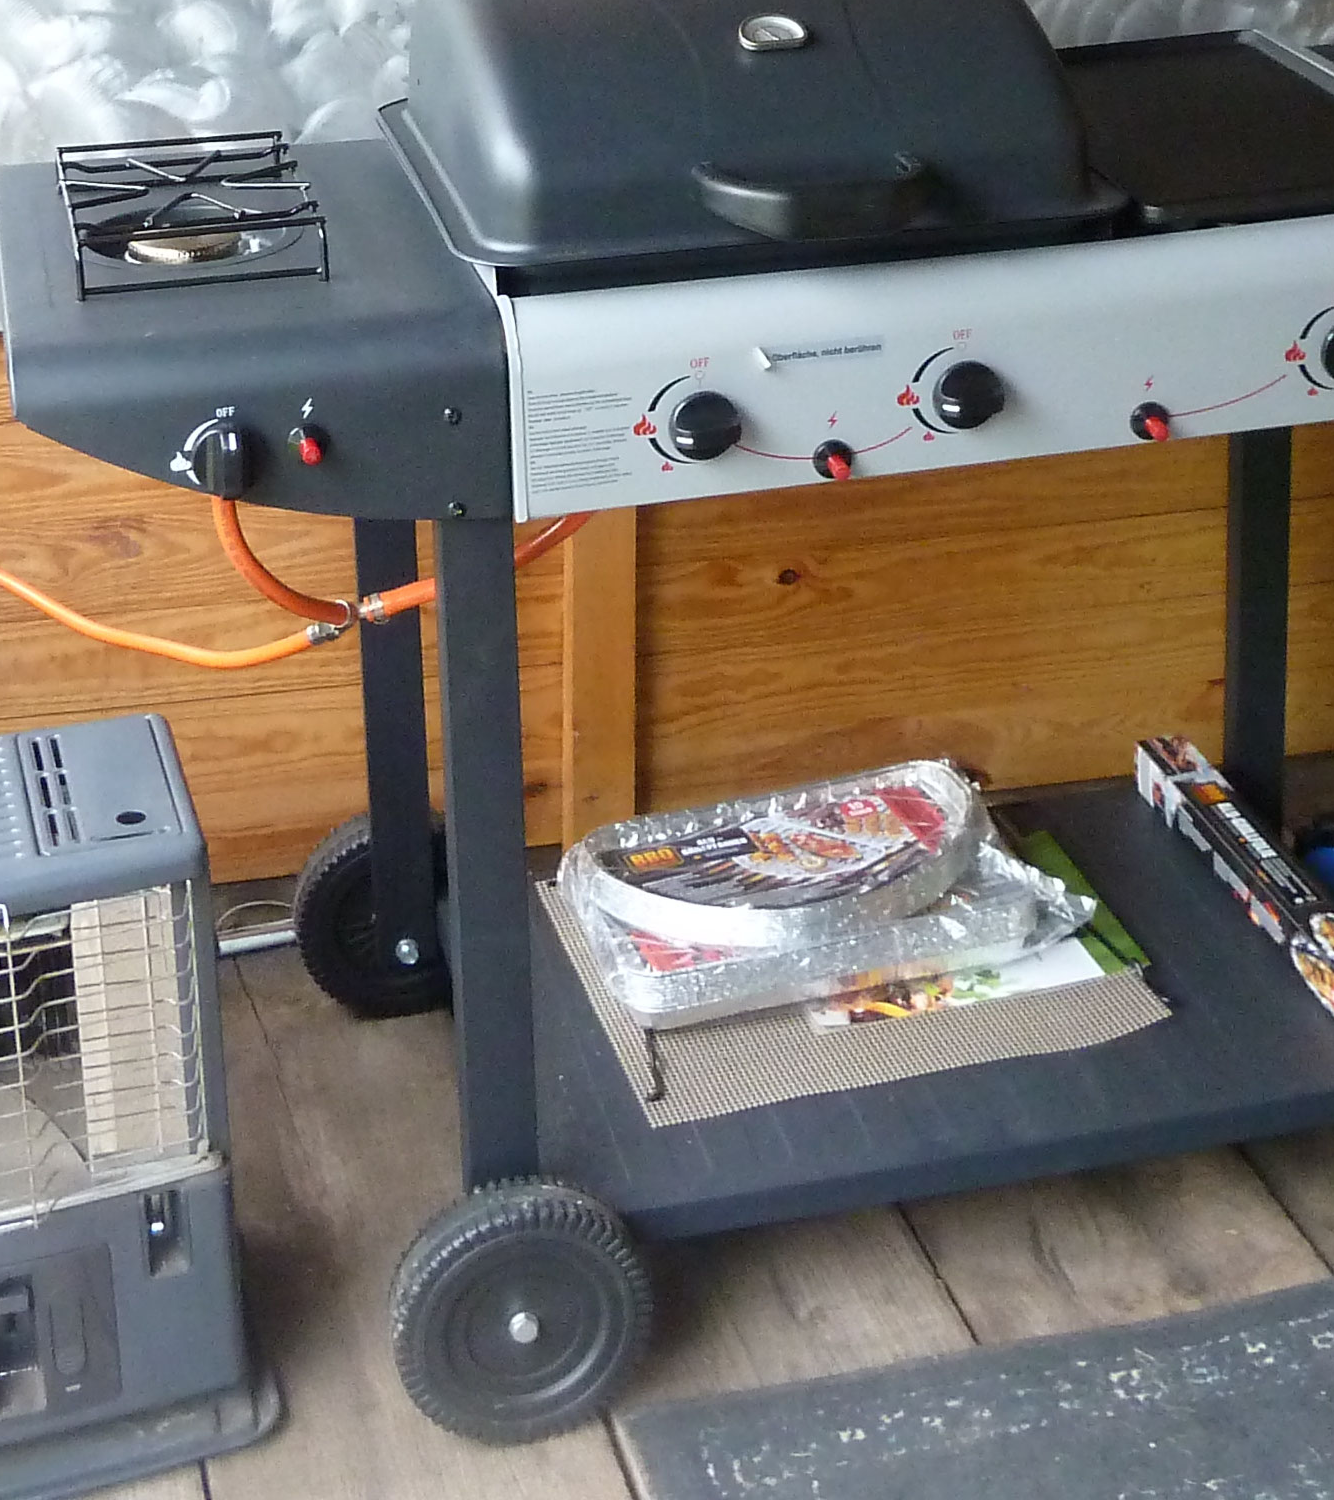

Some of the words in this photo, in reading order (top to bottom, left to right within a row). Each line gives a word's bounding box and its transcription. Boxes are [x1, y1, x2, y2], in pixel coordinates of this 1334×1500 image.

[953, 328, 973, 340] OFF
[689, 357, 710, 368] OFF
[215, 406, 235, 418] OFF
